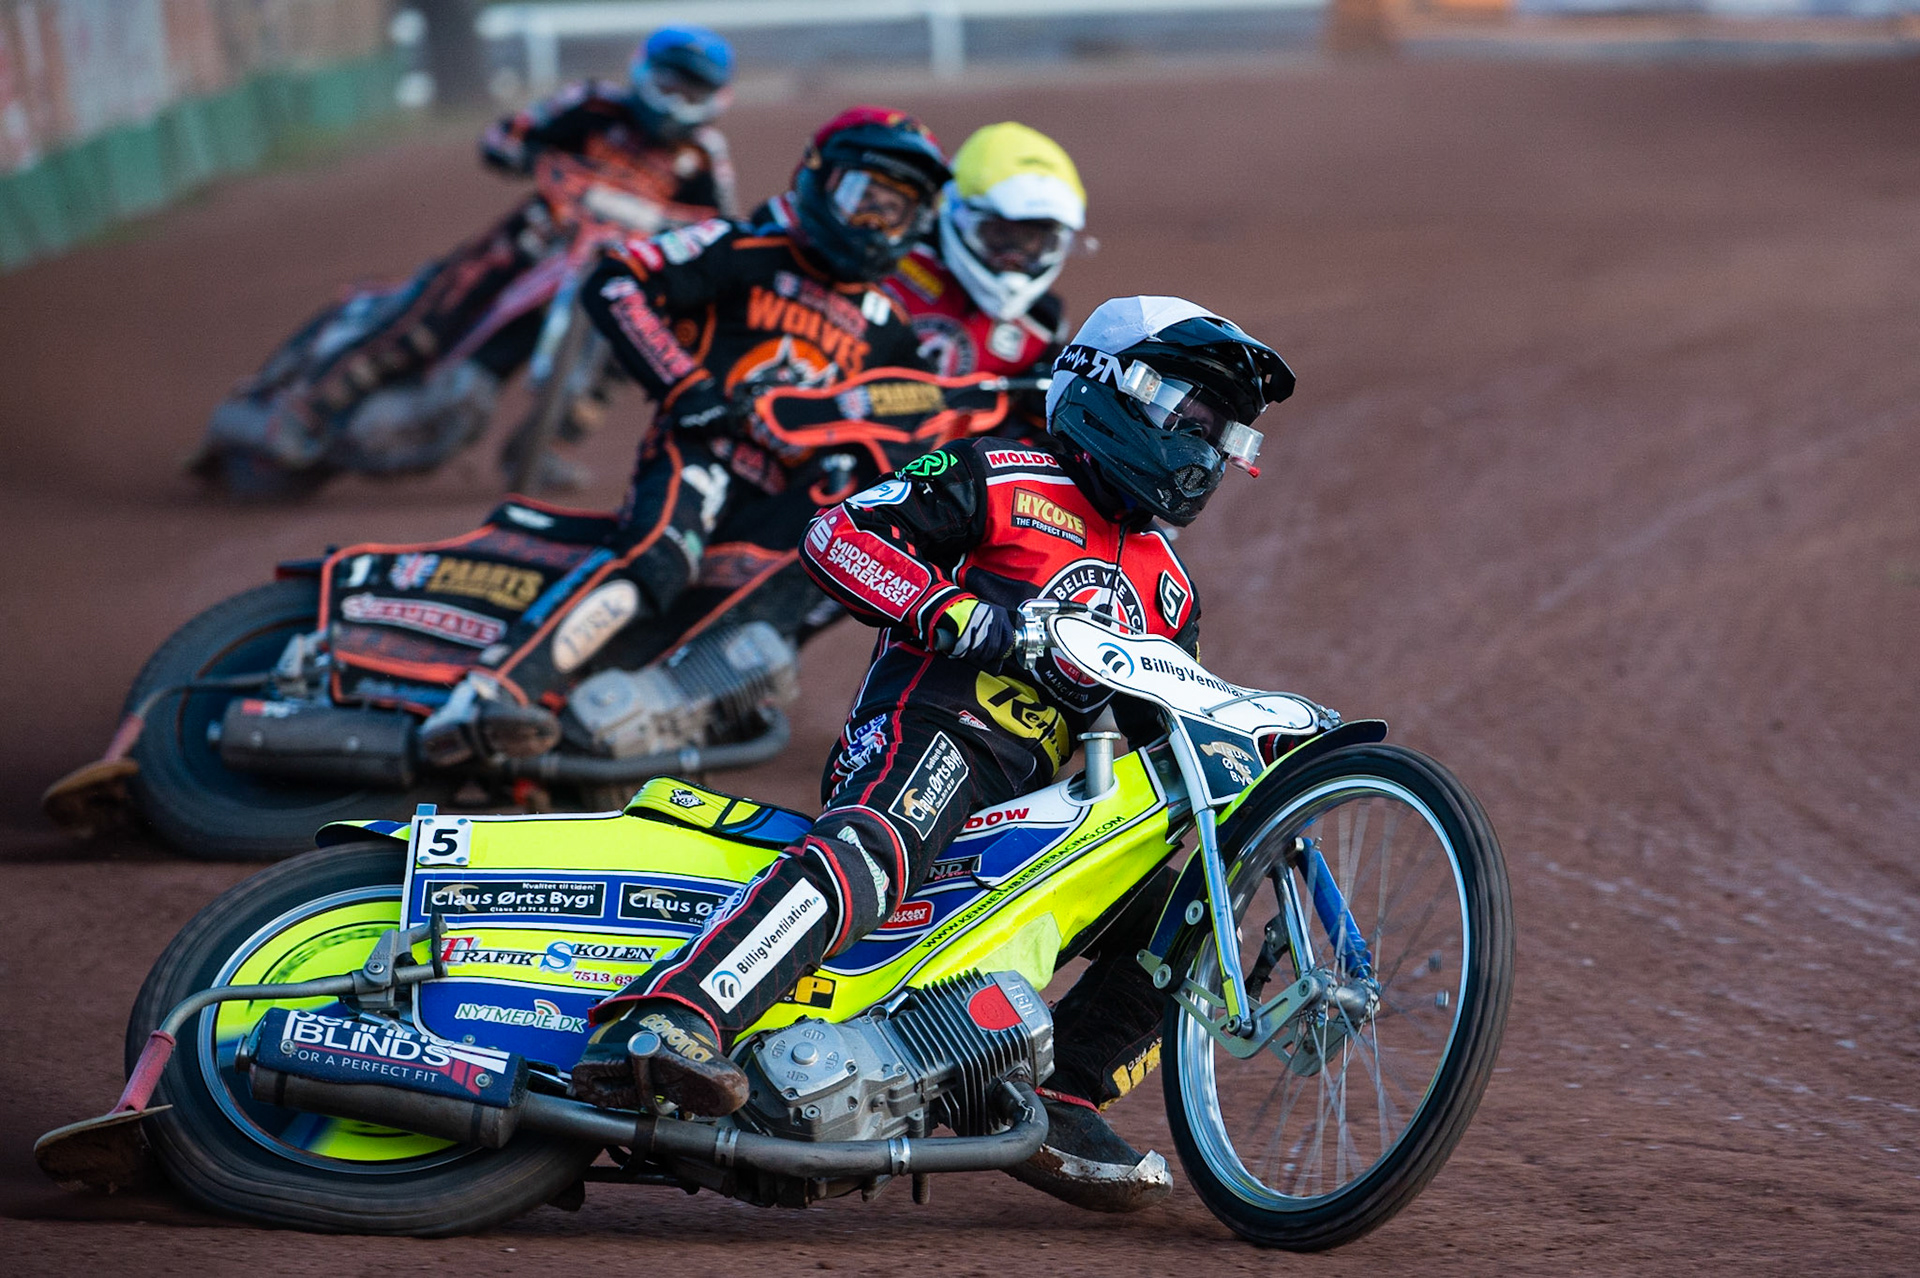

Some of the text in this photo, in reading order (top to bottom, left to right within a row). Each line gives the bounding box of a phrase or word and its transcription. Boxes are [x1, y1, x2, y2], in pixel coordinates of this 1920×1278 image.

[1017, 493, 1084, 534] HYCOTE
[1016, 517, 1084, 545] THE PERFECT FINISH
[827, 548, 910, 607] SPAREKASSE
[832, 537, 920, 598] MIDDELFART
[1053, 569, 1097, 600] BELLE
[1211, 742, 1249, 761] Claus
[909, 787, 937, 822] Claus
[929, 764, 951, 794] Ørts
[427, 828, 459, 857] 5
[431, 891, 493, 906] Claus
[498, 891, 545, 905] Ørts
[629, 892, 691, 912] Claus
[573, 970, 611, 986] 7513
[457, 1003, 586, 1033] NYTMEDIE.DK
[293, 1022, 452, 1067] BLINDS
[325, 1055, 336, 1066] A
[341, 1058, 408, 1079] PERFECT
[415, 1070, 439, 1083] FIT
